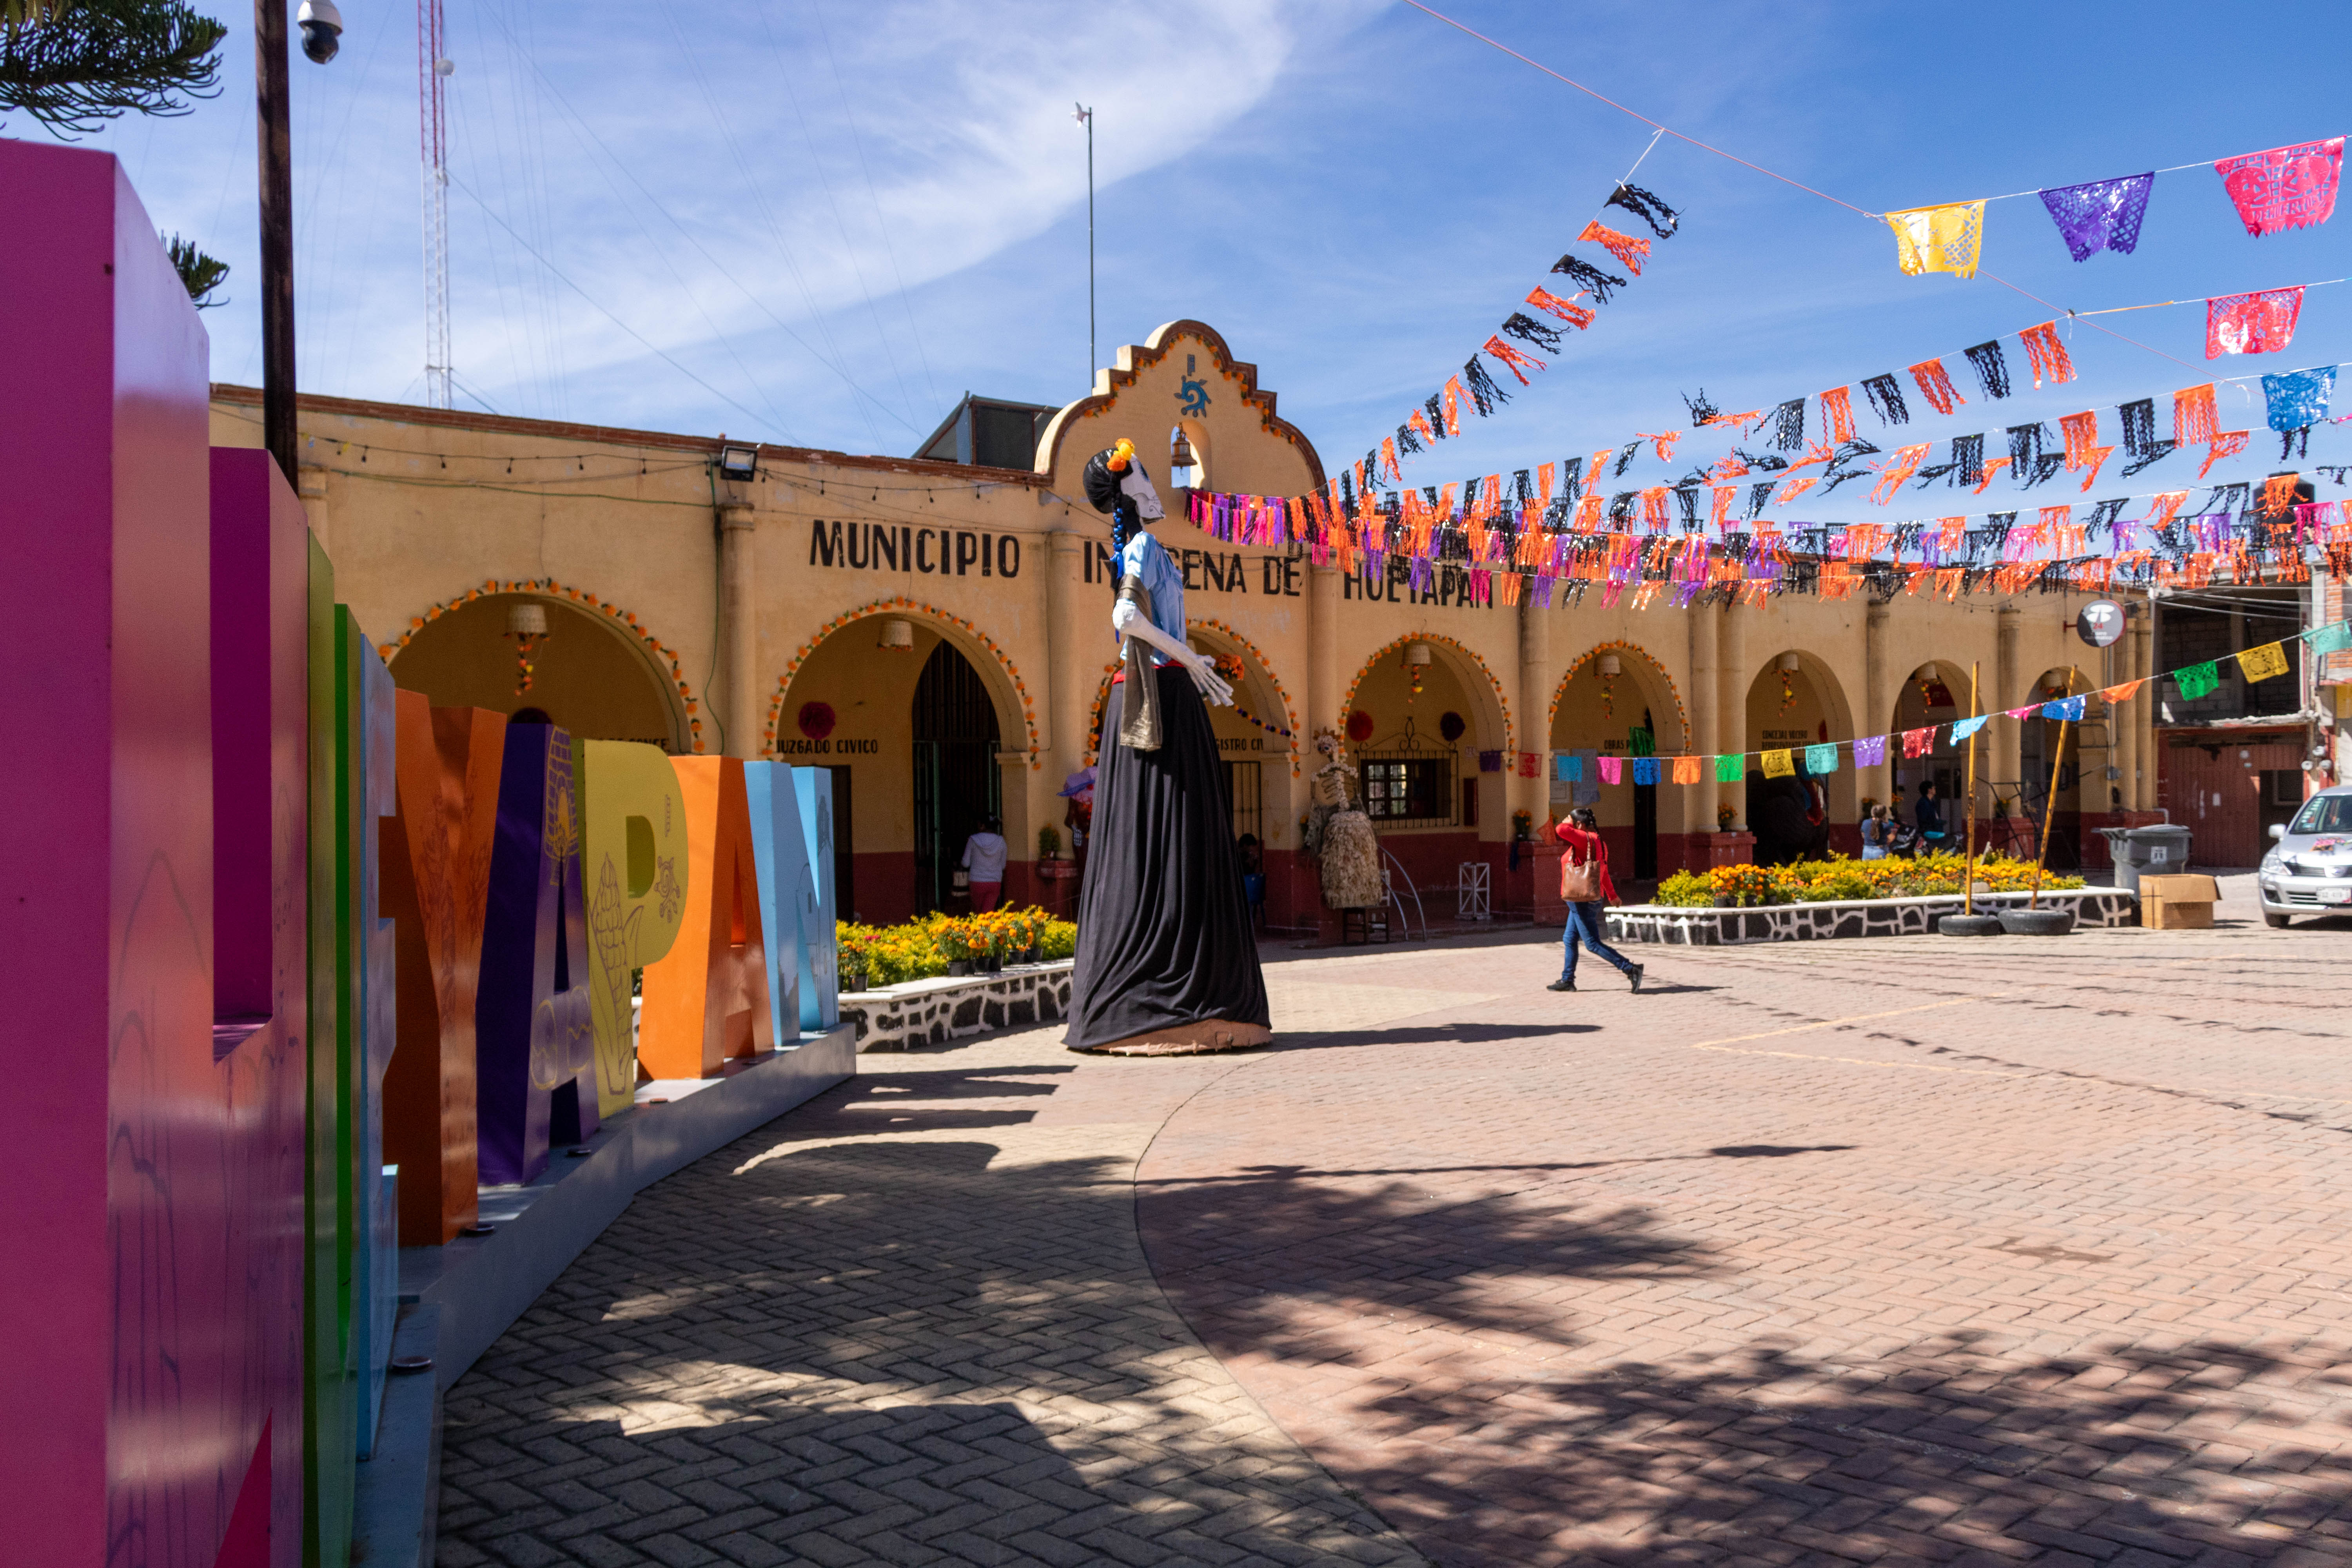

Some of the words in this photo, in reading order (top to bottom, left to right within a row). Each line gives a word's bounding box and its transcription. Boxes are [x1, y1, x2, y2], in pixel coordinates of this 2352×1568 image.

[809, 519, 1019, 578] MUNICIPIO
[1263, 555, 1300, 596] DE
[836, 739, 878, 753] CIVICO
[1215, 738, 1247, 750] GISTRO
